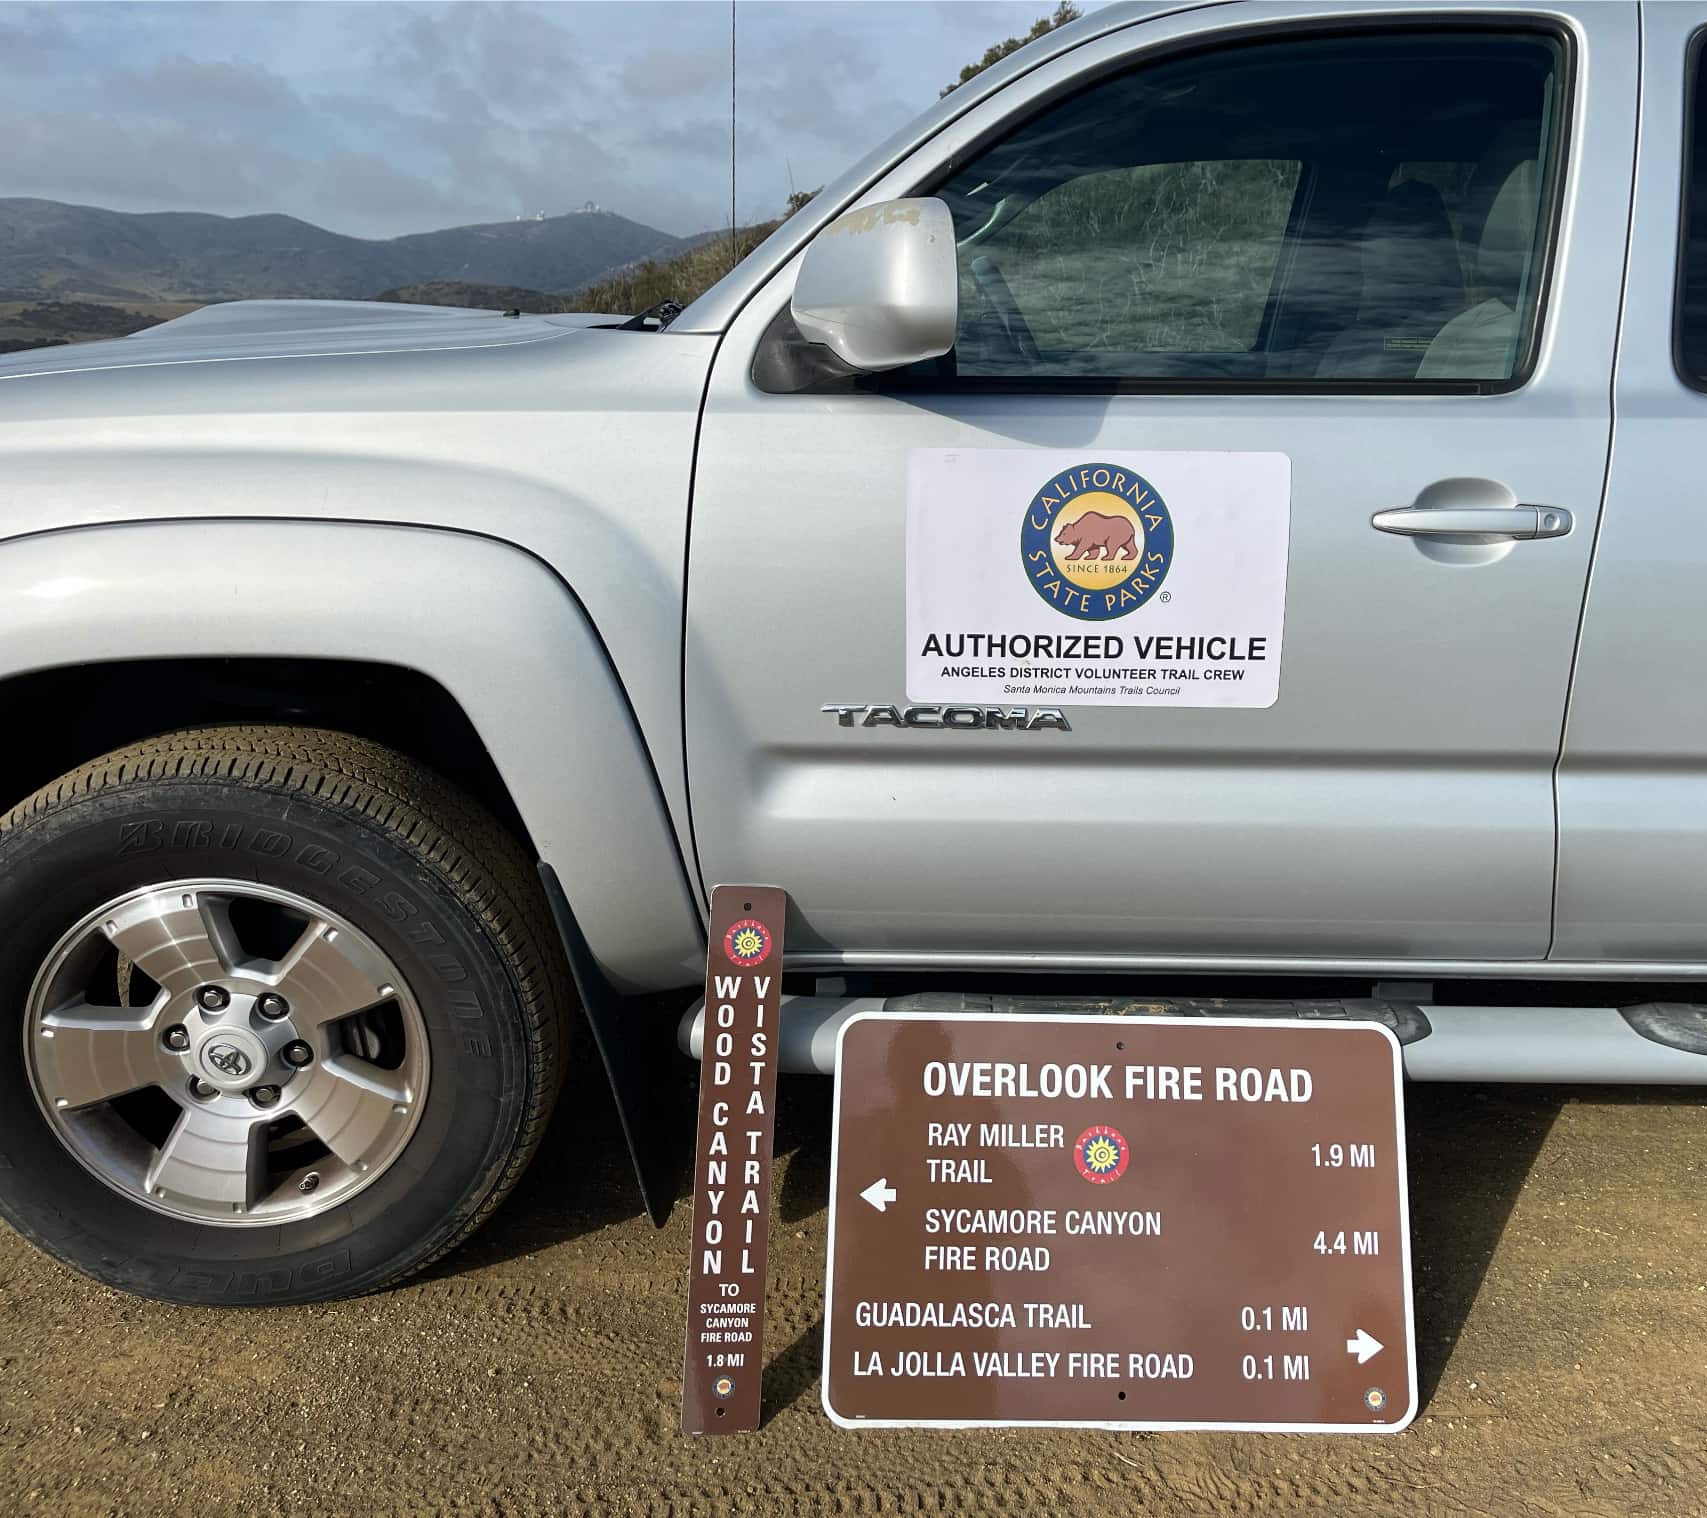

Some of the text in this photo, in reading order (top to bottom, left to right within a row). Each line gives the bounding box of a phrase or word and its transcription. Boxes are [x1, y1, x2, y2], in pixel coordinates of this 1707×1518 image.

[1032, 469, 1163, 531] CALIFORNIA
[1066, 564, 1127, 573] SINCE 1864
[1028, 550, 1164, 612] STATE PARKS
[921, 634, 1266, 660] AUTHORIZED VEHICLE
[941, 667, 1244, 680] ANGELES DISTRICT VOLUNTEER TRAIL CREW
[1004, 685, 1030, 693] Santa
[1069, 686, 1115, 694] Mountains
[1120, 686, 1143, 694] Trails
[1146, 687, 1180, 695] Council
[821, 703, 1072, 731] TACOMA
[114, 818, 494, 1058] BRIDGESTONE
[746, 976, 771, 1114] VISTA
[924, 1062, 1312, 1102] OVERLOOK FIRE ROAD
[703, 976, 741, 1274] WOOD CANYON
[929, 1123, 971, 1146] RAY
[980, 1124, 1064, 1147] MILLER
[1312, 1144, 1374, 1167] 1.9 MI
[927, 1160, 992, 1182] TRAIL
[741, 1131, 762, 1274] TRAIL
[926, 1209, 1160, 1235] SYCAMORE CANYON
[1314, 1231, 1378, 1255] 4.4 MI
[925, 1247, 1049, 1270] FIRE ROAD
[719, 1284, 739, 1296] TO
[701, 1304, 756, 1313] SYCAMORE
[856, 1302, 1091, 1328] GUADALASCA TRAIL
[1242, 1307, 1307, 1330] 0.1 MI
[706, 1318, 748, 1328] CANYON
[701, 1332, 752, 1342] FIRE ROAD
[707, 1354, 744, 1366] 1.8 MI
[854, 1352, 1193, 1378] LA JOLLA VALLEY FIRE ROAD
[1243, 1355, 1309, 1379] 0.1 MI
